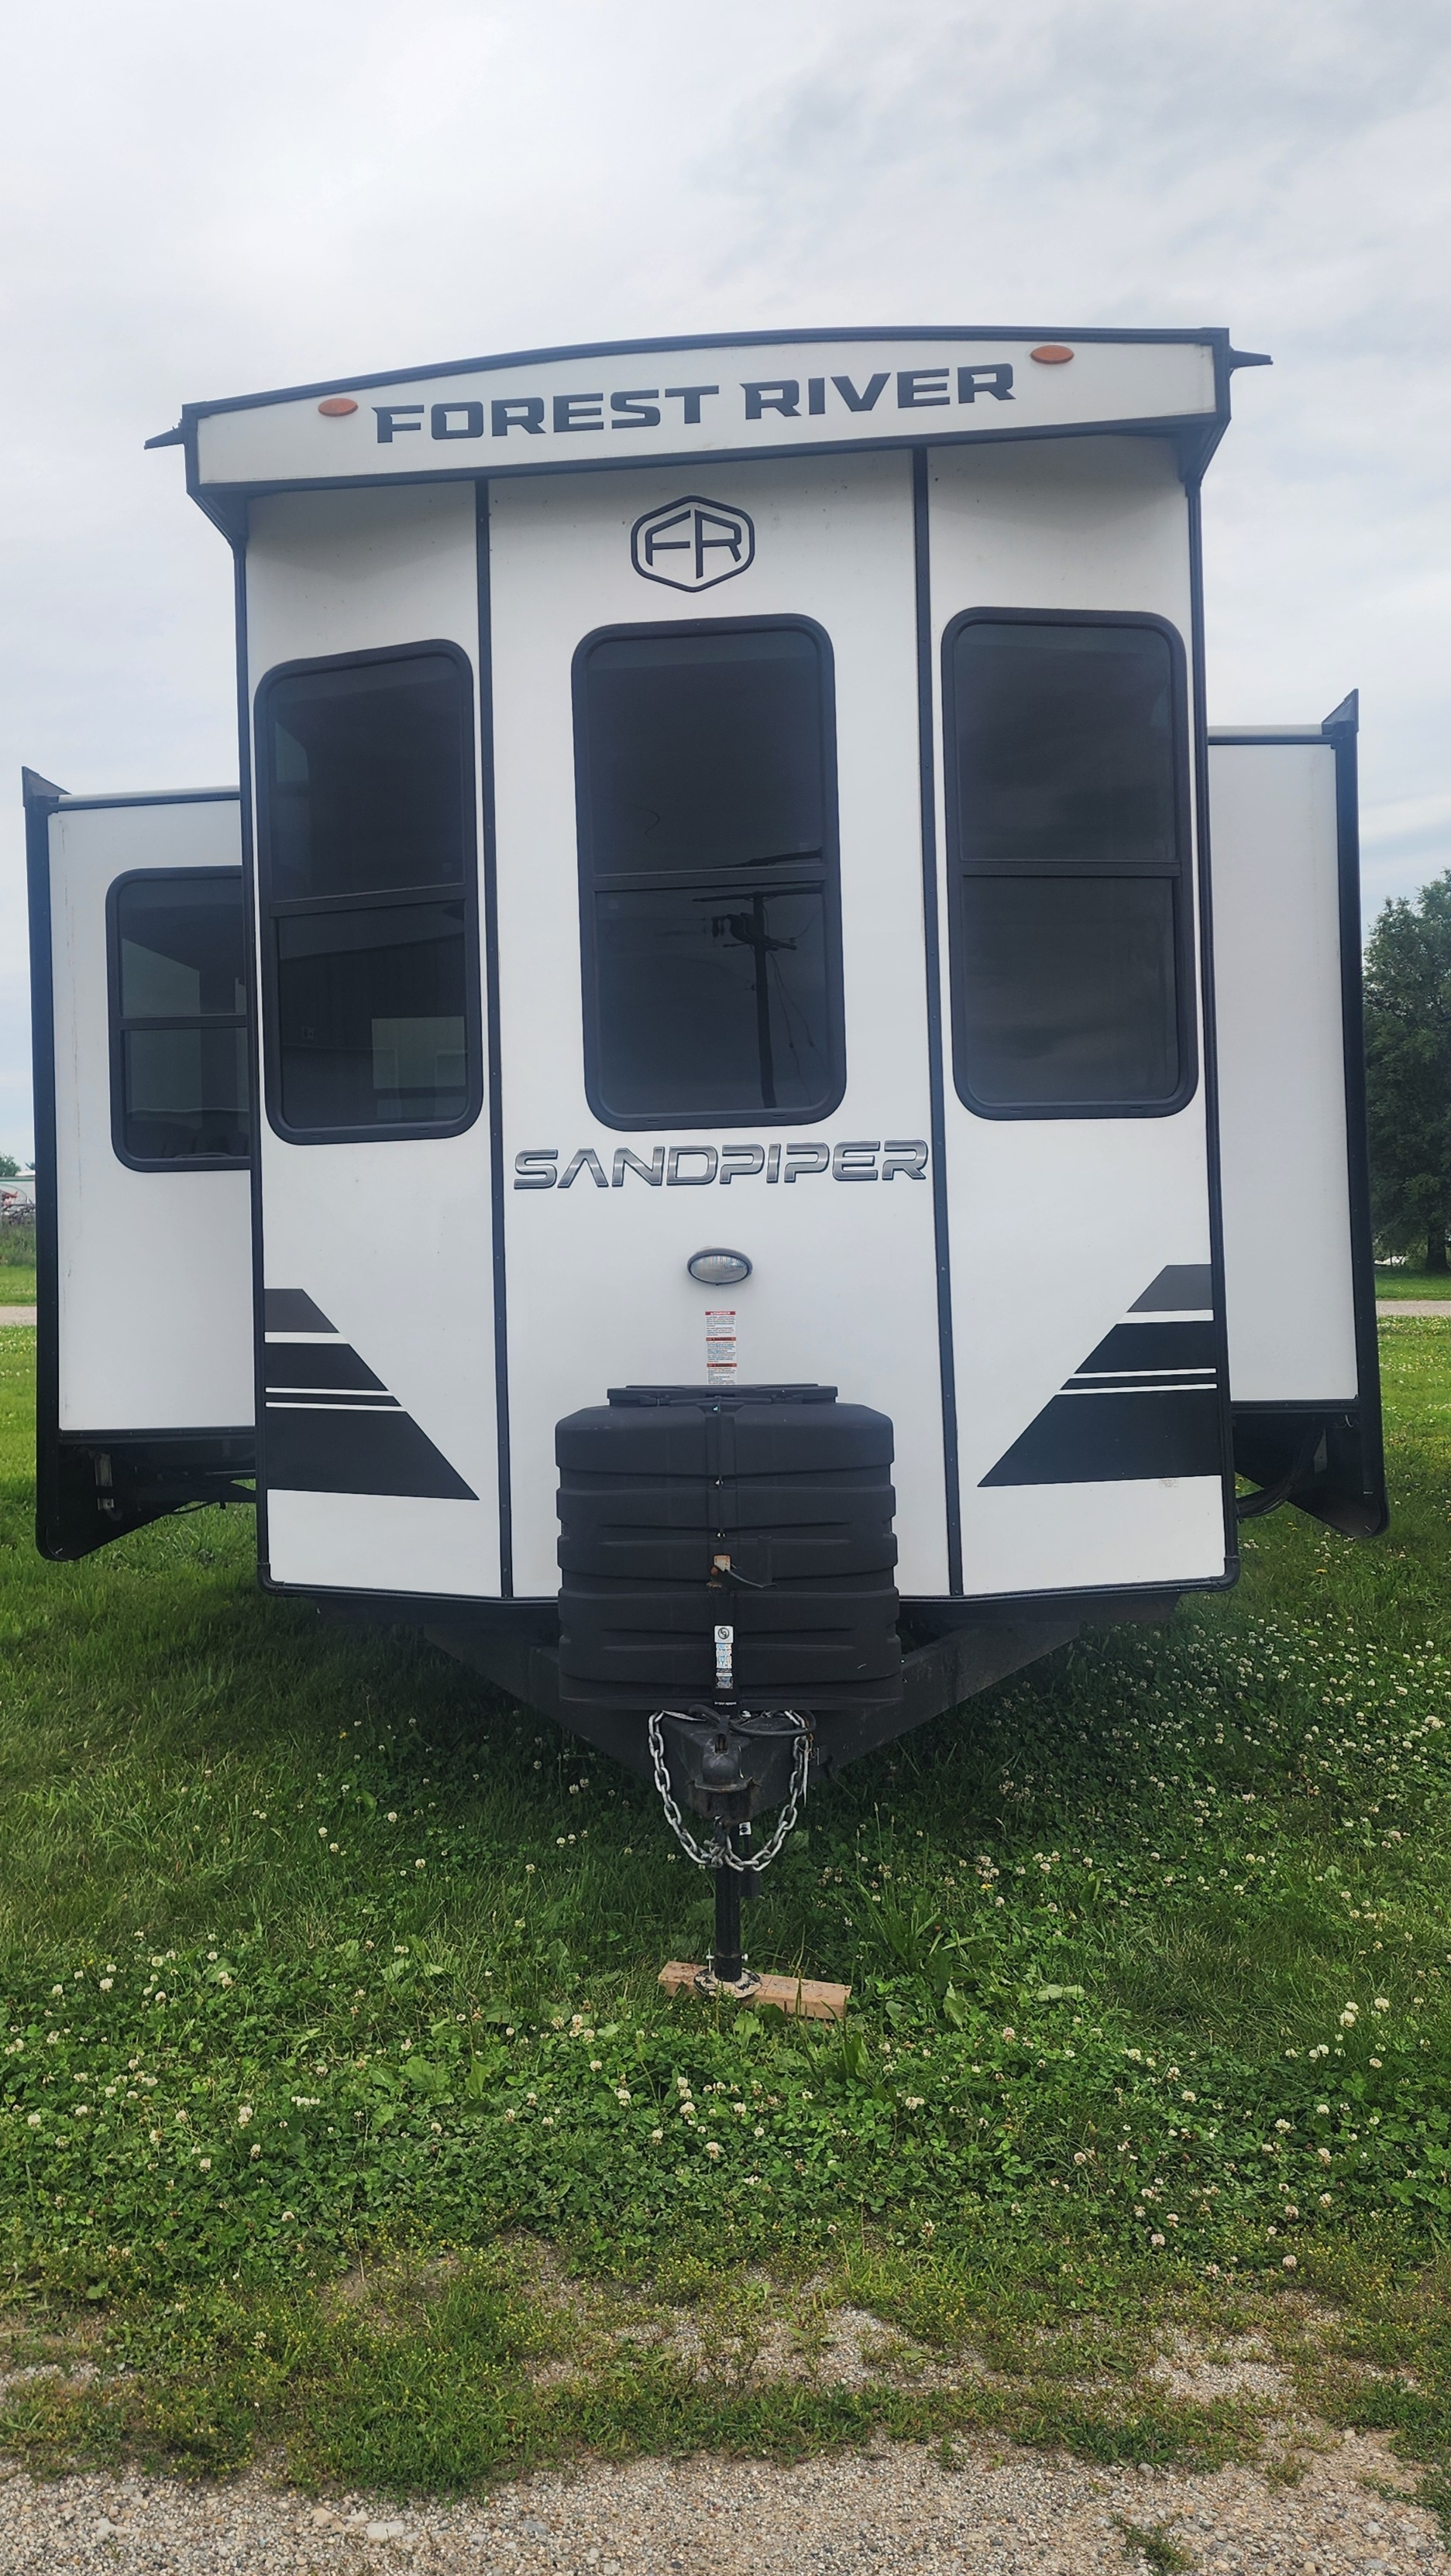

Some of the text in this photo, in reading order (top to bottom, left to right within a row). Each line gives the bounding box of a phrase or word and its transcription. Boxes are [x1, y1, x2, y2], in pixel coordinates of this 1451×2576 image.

[371, 363, 1016, 444] FOREST RIVER
[645, 508, 742, 579] FR
[513, 1139, 929, 1190] SANDPIPER
